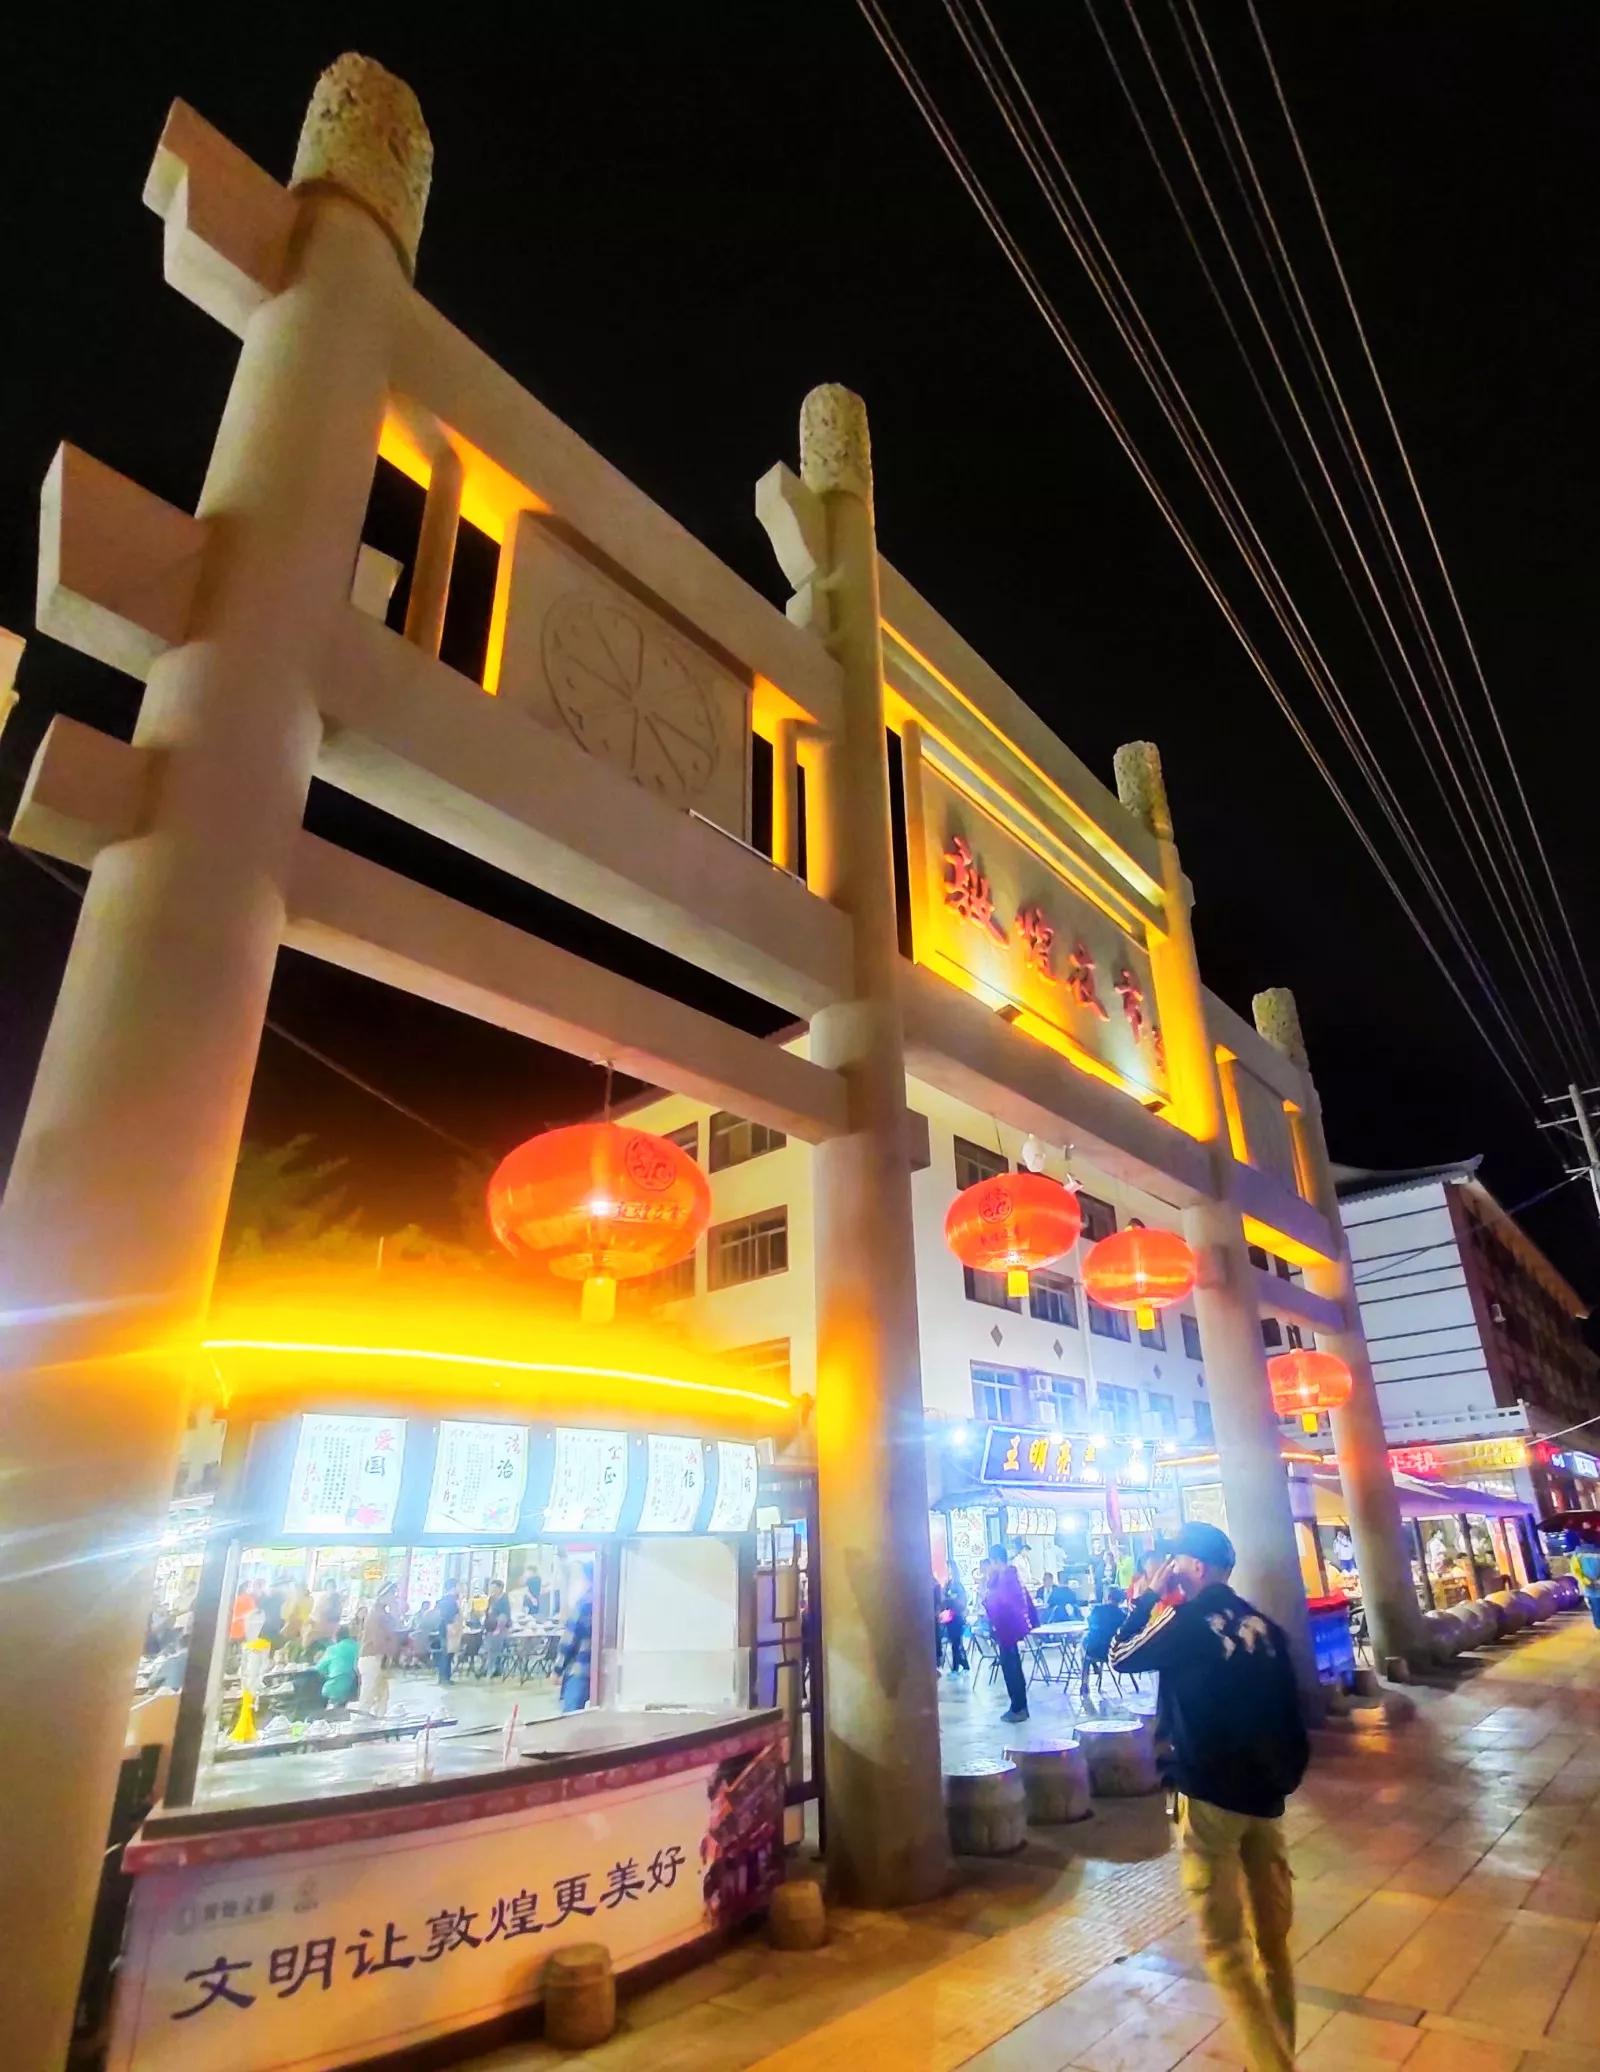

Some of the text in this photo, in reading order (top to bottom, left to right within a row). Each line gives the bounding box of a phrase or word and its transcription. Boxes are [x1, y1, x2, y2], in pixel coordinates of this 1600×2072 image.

[172, 1846, 687, 2019] 文明让敦煌更美好
